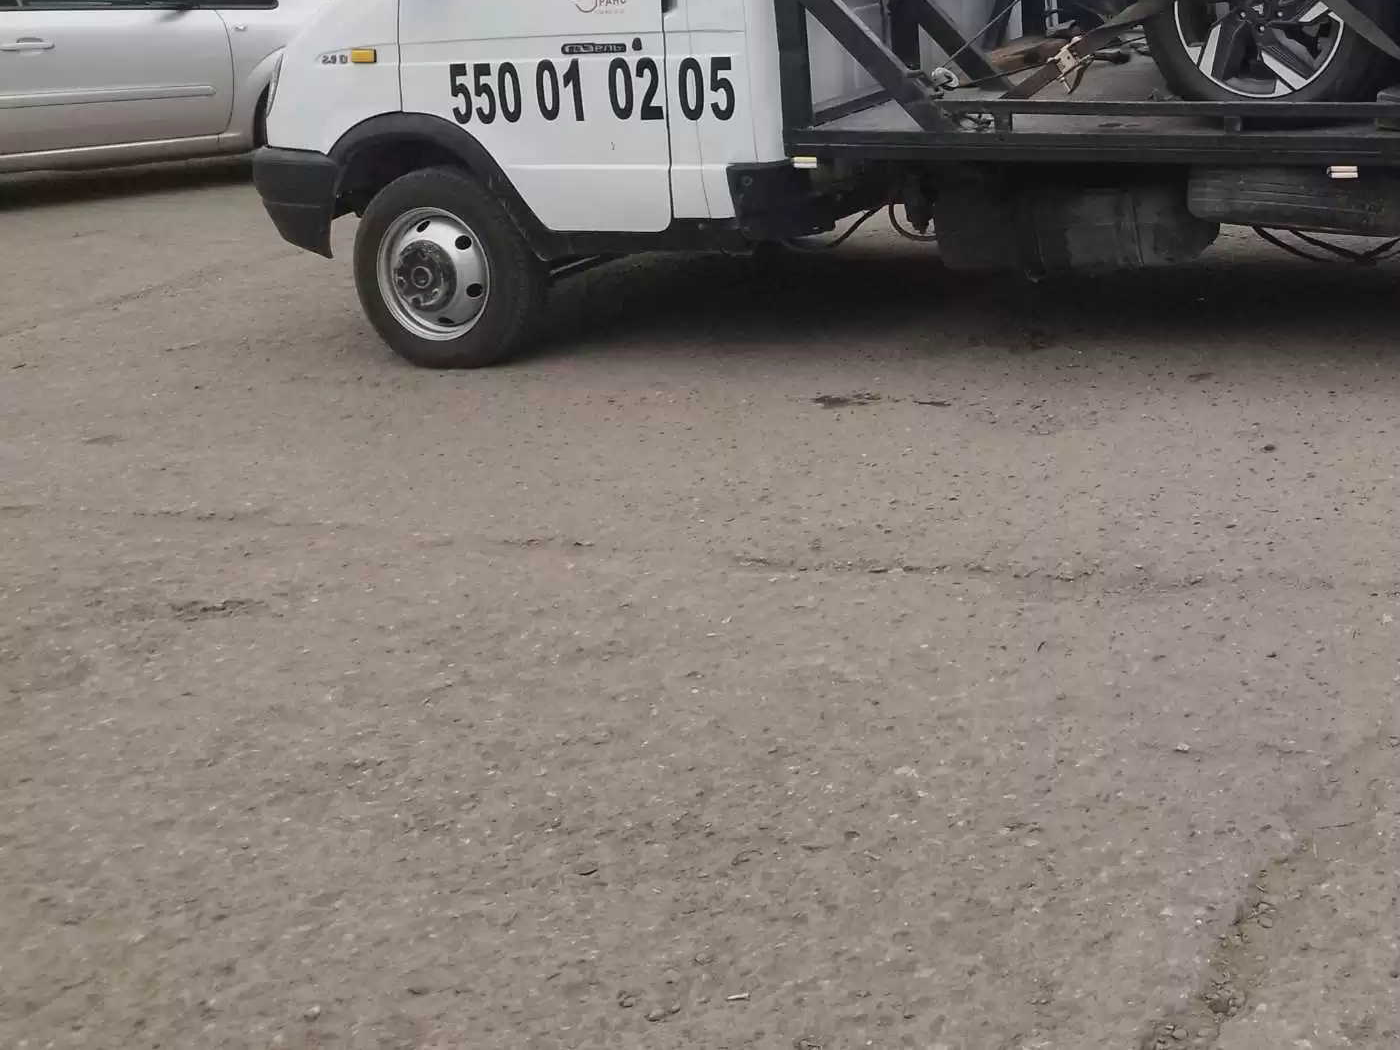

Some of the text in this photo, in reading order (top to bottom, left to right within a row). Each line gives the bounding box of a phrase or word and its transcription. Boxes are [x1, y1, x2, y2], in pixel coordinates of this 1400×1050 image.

[449, 56, 736, 125] 550 01 02 05
